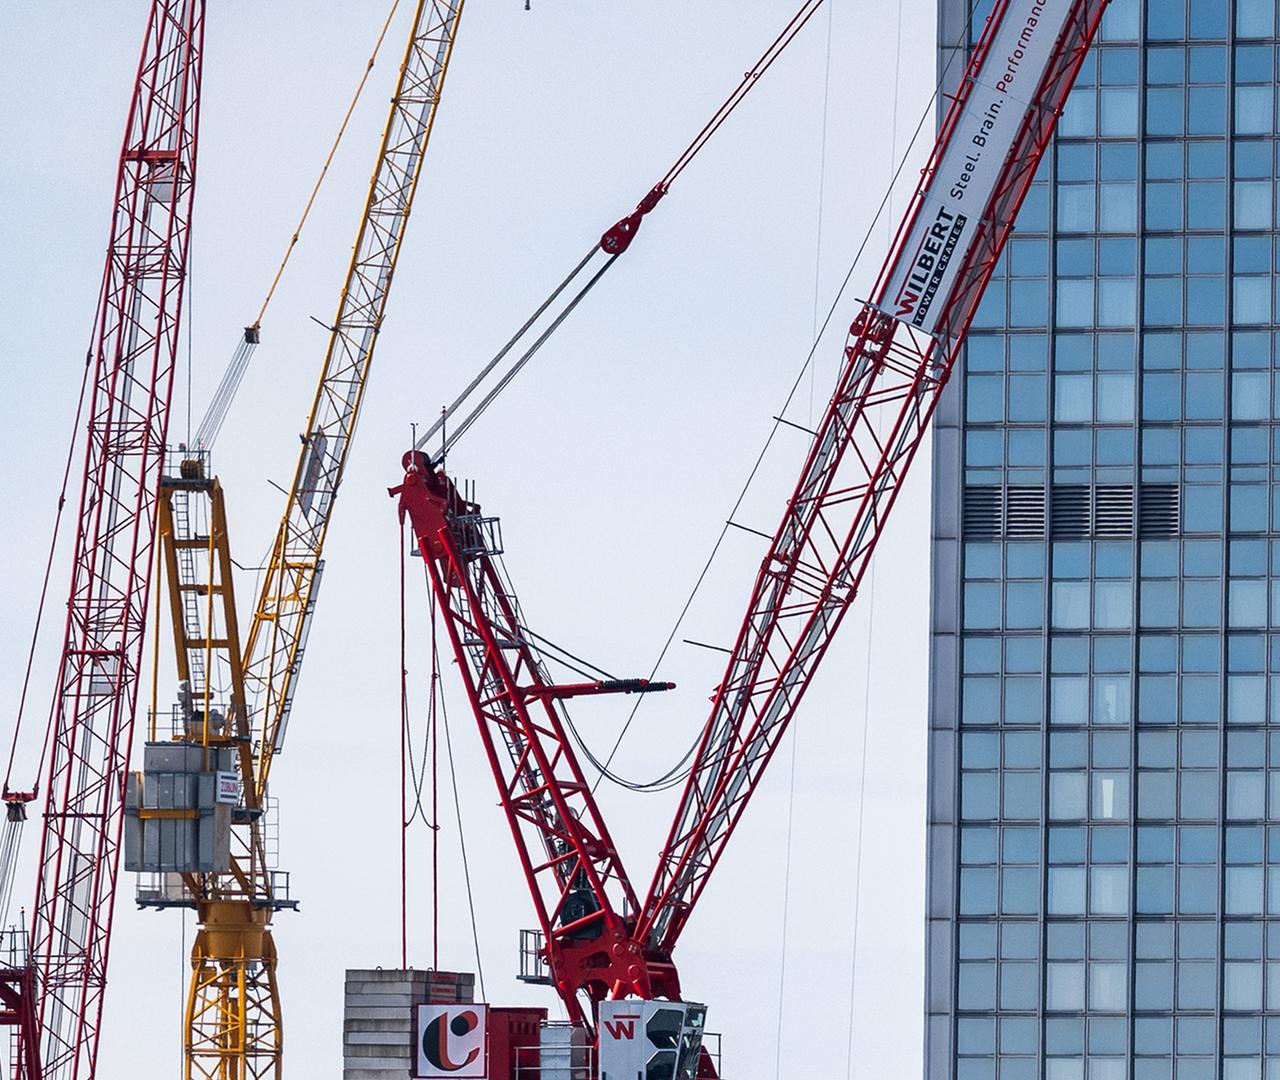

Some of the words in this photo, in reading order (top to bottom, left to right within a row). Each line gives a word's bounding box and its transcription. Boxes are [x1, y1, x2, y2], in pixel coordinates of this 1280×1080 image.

[950, 153, 980, 200] Steel.
[972, 100, 1003, 147] Brain.
[895, 205, 954, 317] WILBERT
[915, 276, 941, 326] TOWER
[938, 219, 965, 271] CRANES
